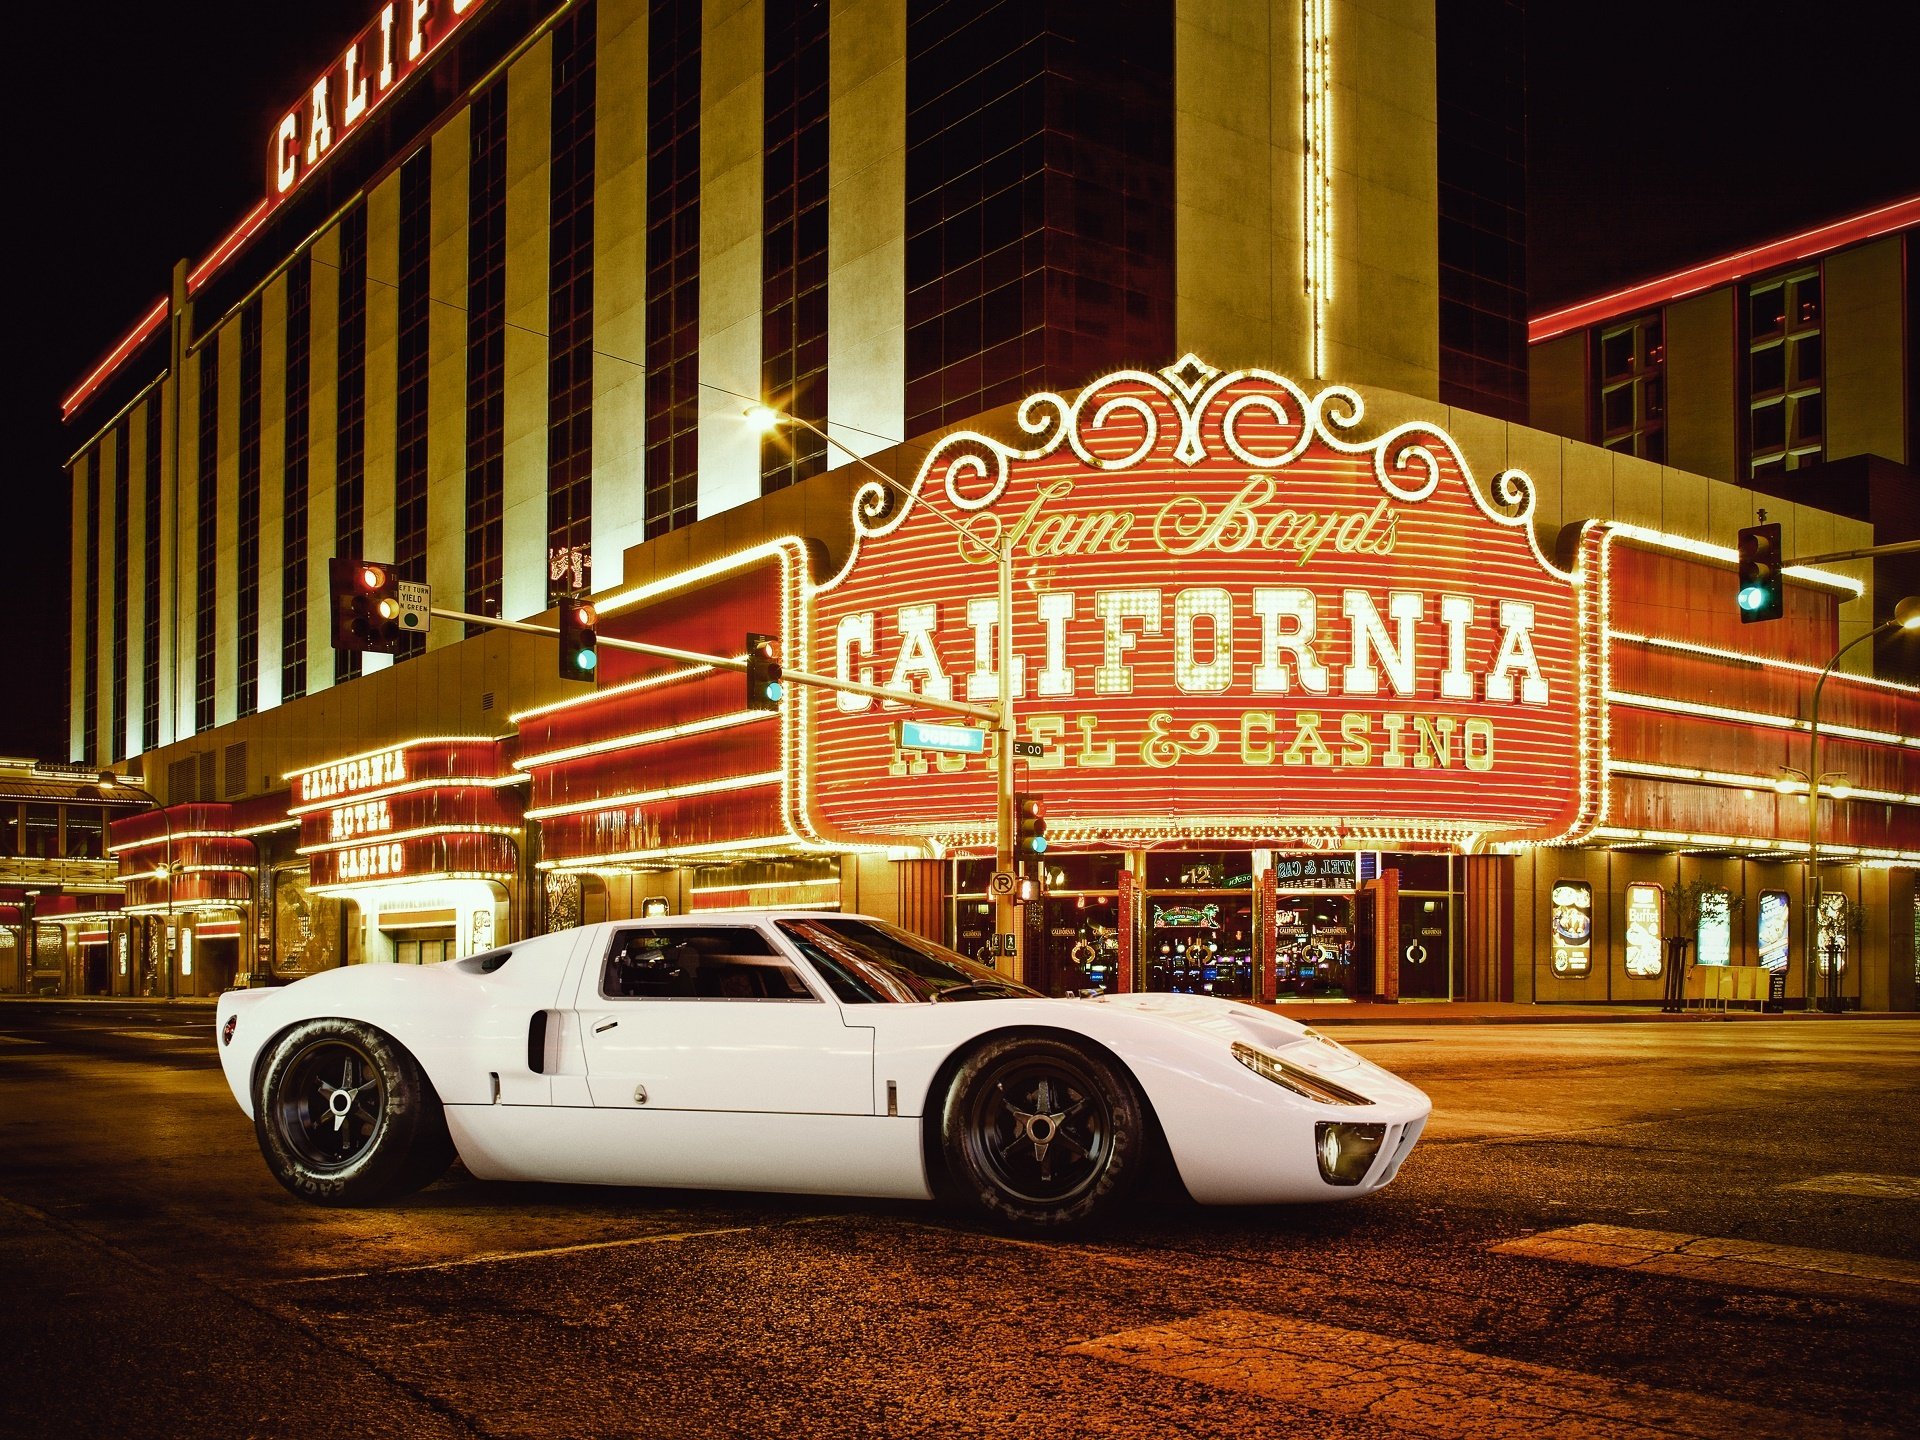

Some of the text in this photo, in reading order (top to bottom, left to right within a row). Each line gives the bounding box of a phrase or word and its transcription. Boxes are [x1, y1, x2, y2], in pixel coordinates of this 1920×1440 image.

[277, 0, 475, 193] CALIF
[957, 473, 1400, 567] Sam Boyd's
[402, 594, 422, 603] YIELD
[407, 604, 428, 612] GREEN
[836, 587, 1549, 713] CALIFORNIA
[1014, 744, 1041, 755] E 00
[1139, 710, 1220, 768] &
[1240, 711, 1494, 771] CASINO
[302, 750, 406, 801] CALIFORNIA
[331, 800, 391, 839] HOTEL
[338, 843, 403, 879] CASINO
[1629, 908, 1659, 922] Buffet
